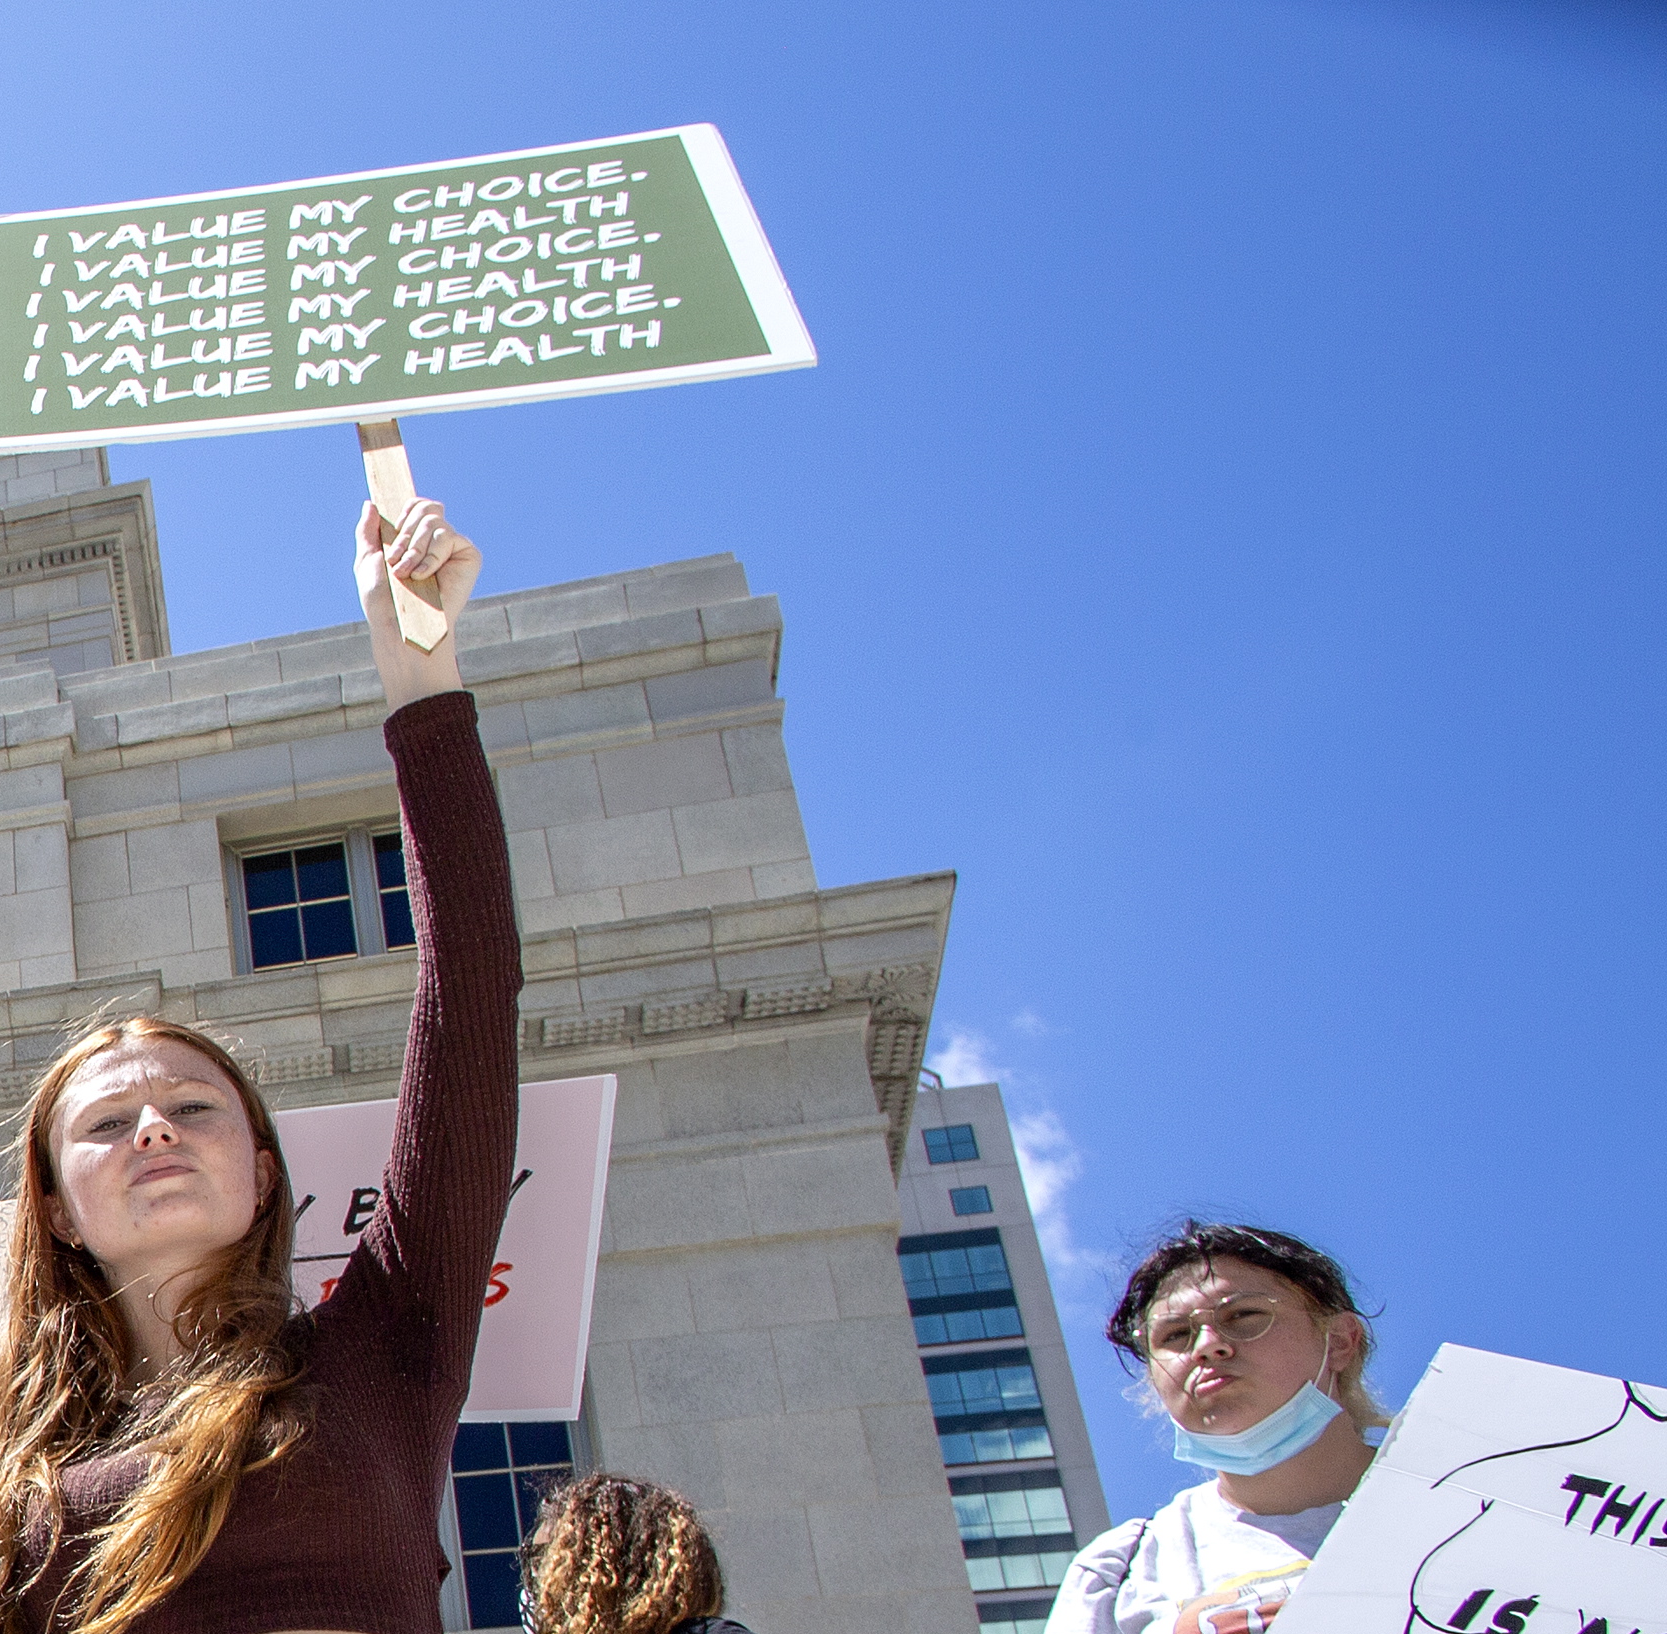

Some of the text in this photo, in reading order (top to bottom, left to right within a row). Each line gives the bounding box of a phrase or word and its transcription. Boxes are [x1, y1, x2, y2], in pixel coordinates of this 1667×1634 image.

[33, 160, 648, 258] I VALUE MY CHOICE.
[40, 191, 629, 287] I VALUE MY HEALTH
[26, 220, 662, 318] I VALUE MY CHOICE.
[33, 253, 642, 348] I VALUE MY HEALTH
[23, 284, 682, 382] I VALUE MY CHOICE.
[30, 319, 661, 415] I VALUE MY HEALTH
